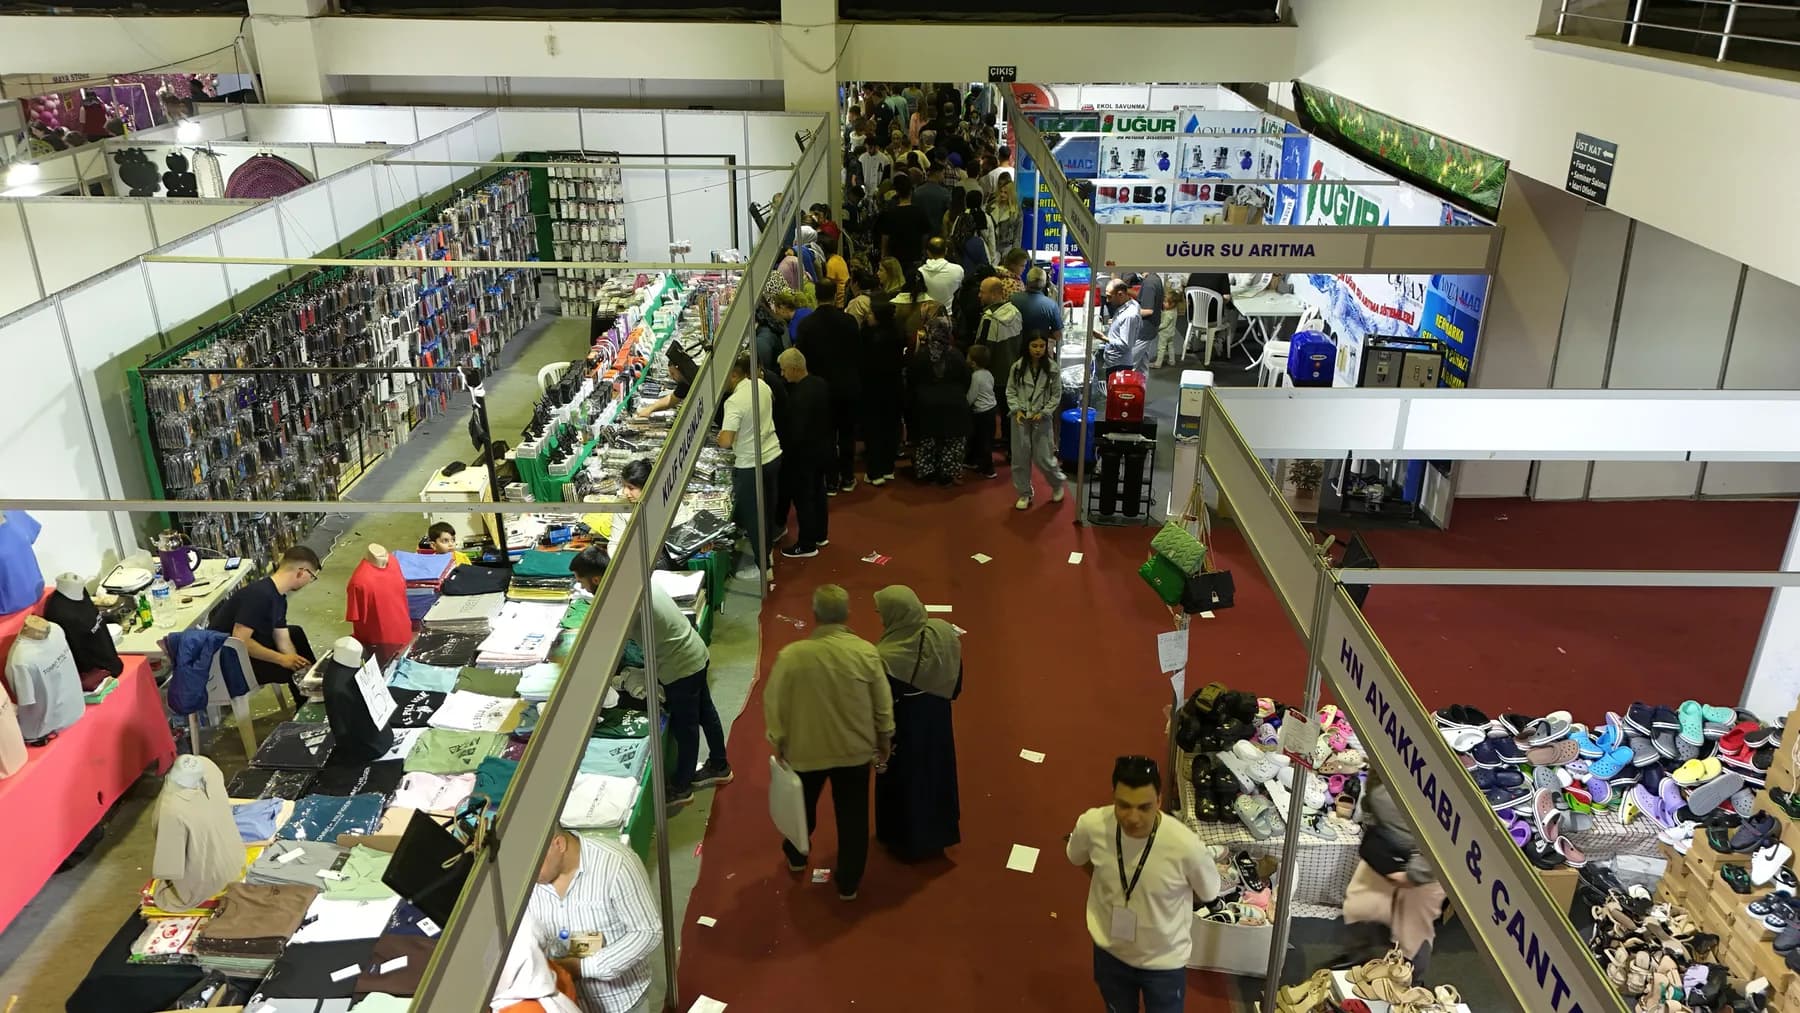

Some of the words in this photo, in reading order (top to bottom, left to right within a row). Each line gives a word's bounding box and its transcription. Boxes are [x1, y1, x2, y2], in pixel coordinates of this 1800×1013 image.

[990, 67, 1014, 76] ÇIKIŞ
[1117, 116, 1176, 132] UĞUR
[1575, 139, 1588, 152] ÜST
[1588, 145, 1602, 156] KAT
[1166, 240, 1215, 257] UĞUR
[1220, 243, 1244, 257] SU
[1248, 243, 1315, 257] ARITMA
[662, 456, 678, 508] KILIF
[1340, 637, 1363, 690] HN
[1365, 681, 1462, 845] AYAKKABI
[1465, 839, 1482, 884] &
[1491, 879, 1583, 1013] ÇANT
